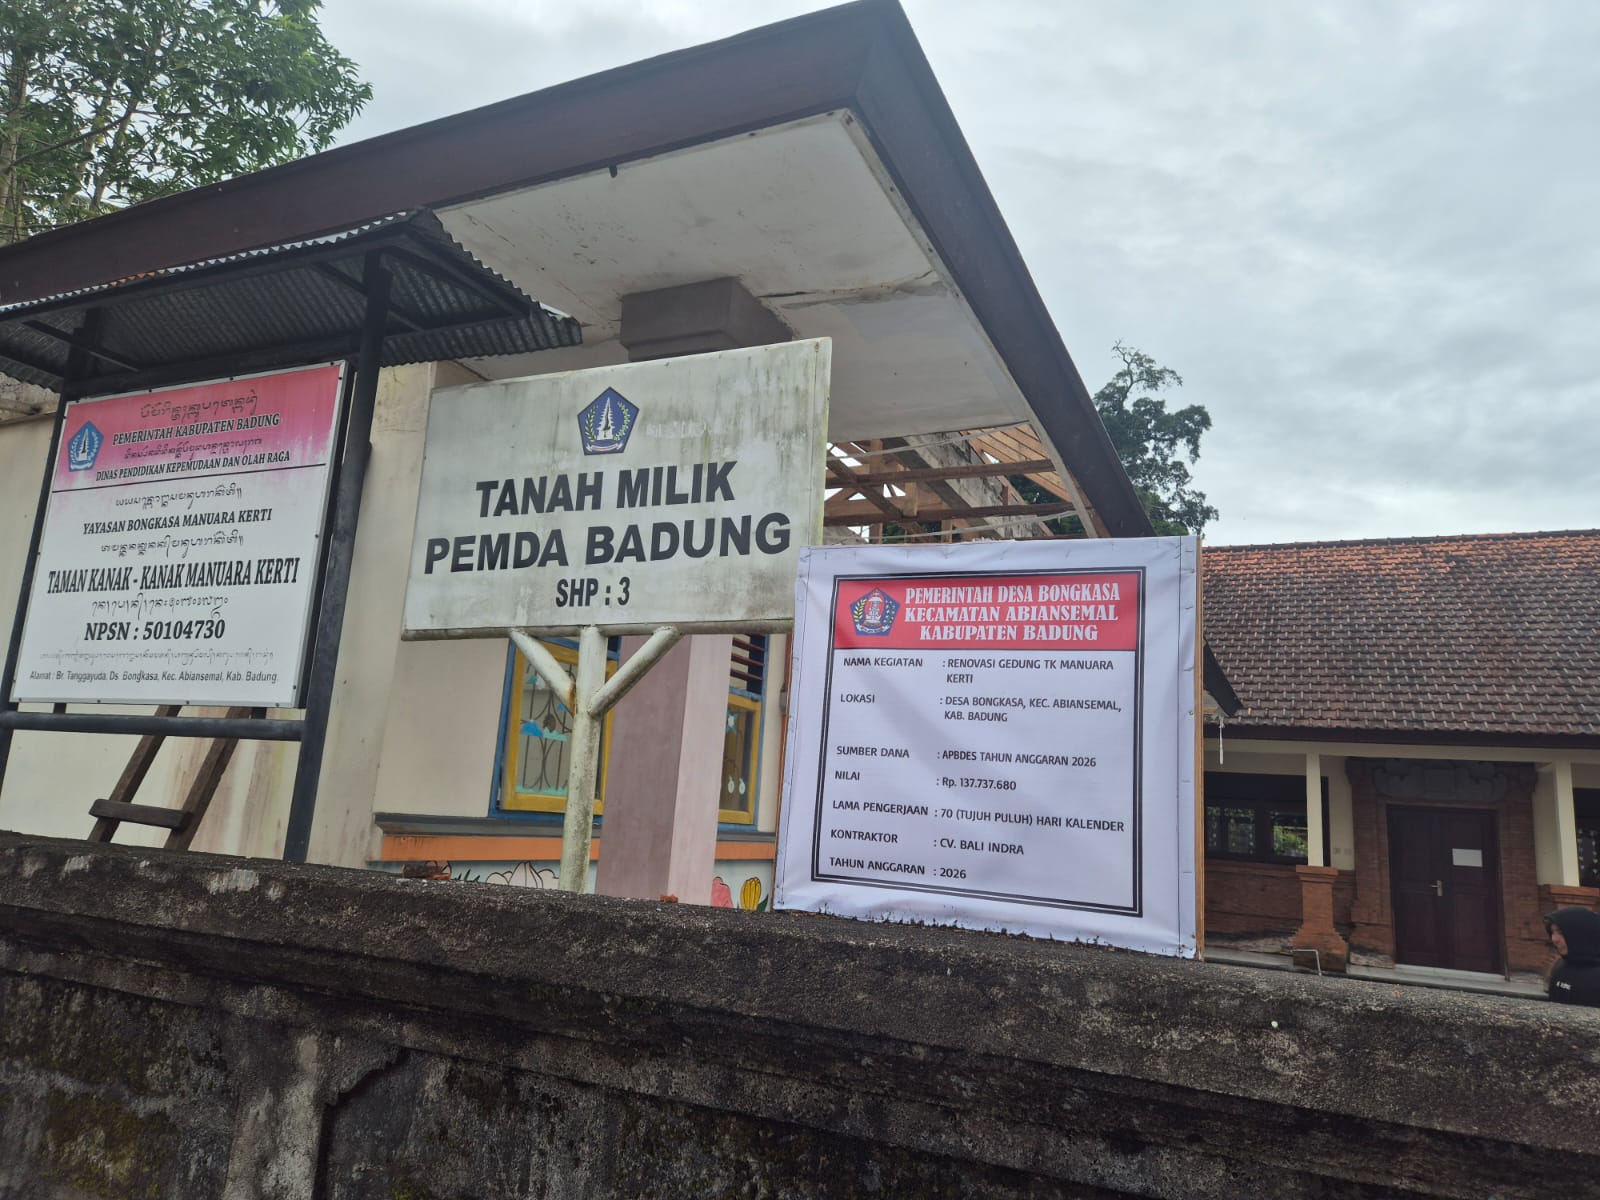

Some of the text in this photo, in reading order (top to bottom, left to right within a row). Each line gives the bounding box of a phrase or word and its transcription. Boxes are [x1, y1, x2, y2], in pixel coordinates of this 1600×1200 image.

[112, 413, 280, 446] PEMERINTAH KABUPATEN BADUNG
[96, 450, 290, 481] DINAS PENDIDIKAN KEPEMUDAAN DAN OLAH RAGA
[475, 460, 738, 518] TANAH MILIK
[83, 508, 272, 534] YAYASAN BONGKASA MANUARA KERTI
[424, 512, 792, 575] PEMDA BADUNG
[47, 568, 88, 594] TAMAN
[88, 566, 134, 592] KANAK
[140, 563, 185, 590] KANAK
[184, 560, 252, 587] MANUARA
[254, 557, 300, 584] KERTI
[555, 578, 600, 608] SHP
[617, 576, 631, 606] 3
[905, 582, 1121, 604] PEMERINTAH DESA BONGKASA
[904, 604, 1119, 622] KECAMATAN ABIANSEMAL
[84, 622, 131, 640] NPSN
[142, 619, 226, 640] 50104730
[920, 624, 1098, 641] KABUPATEN BADUNG
[843, 657, 872, 667] NAMA
[874, 657, 924, 668] KEGIATAN
[947, 658, 996, 669] RENOVASI
[998, 658, 1041, 670] GEDUNG
[1044, 659, 1057, 670] TK
[1060, 660, 1114, 670] MANUARA
[946, 674, 974, 684] KERTI
[840, 694, 876, 704] LOKASI
[945, 696, 970, 706] DESA
[972, 696, 1026, 710] BONGKASA,
[1029, 698, 1050, 708] KEC.
[1052, 698, 1122, 712] ABIANSEMAL,
[944, 710, 1008, 722] KAB. BADUNG
[836, 746, 878, 756] SUMBER
[880, 748, 910, 759] DANA
[942, 750, 977, 761] APBDES
[980, 752, 1012, 763] TAHUN
[1014, 753, 1069, 766] ANGGARAN
[1071, 756, 1097, 768] 2026
[834, 770, 860, 781] NILAI
[942, 776, 957, 789] Rp.
[960, 778, 1017, 791] 137.737.680
[832, 800, 860, 811] LAMA
[863, 802, 929, 816] PENGERJAAN
[940, 808, 953, 819] 70
[956, 809, 992, 822] (TUJUH
[994, 812, 1033, 826] PULUH)
[1036, 816, 1062, 828] HARI
[1065, 818, 1125, 832] KALENDER
[830, 828, 898, 844] KONTRAKTOR
[940, 838, 957, 849] CV.
[960, 840, 984, 852] BALI
[988, 842, 1025, 856] INDRA
[830, 856, 864, 870] TAHUN
[867, 860, 926, 876] ANGGARAN
[939, 868, 967, 880] 2026
